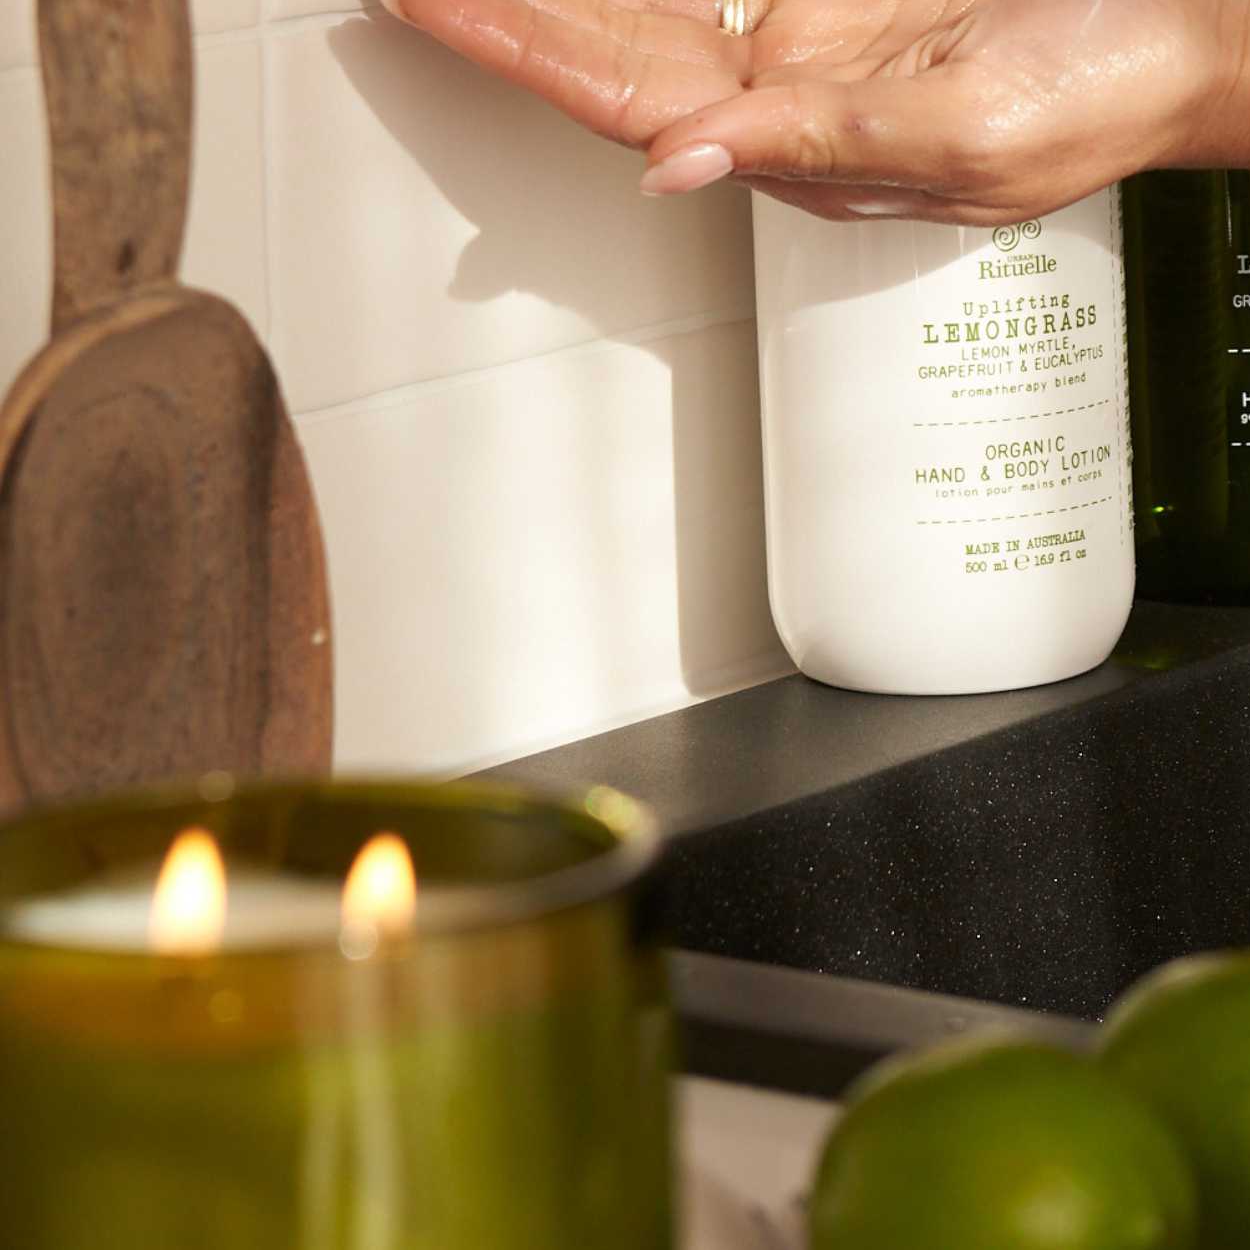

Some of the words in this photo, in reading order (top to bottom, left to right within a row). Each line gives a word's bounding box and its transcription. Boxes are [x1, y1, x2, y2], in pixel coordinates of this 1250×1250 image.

[978, 254, 1057, 279] Rituelle
[963, 294, 1070, 316] Uplifting
[923, 305, 1097, 344] LEMONGRASS
[962, 346, 1010, 361] LEMON
[1019, 337, 1076, 355] MYRTLE,
[918, 360, 1013, 379] GRAPEFRUIT
[1020, 360, 1027, 372] &
[1035, 345, 1104, 370] EUCALYPTUS
[951, 381, 1048, 398] aromatherapy
[1055, 374, 1087, 388] blend
[985, 436, 1065, 460] ORGANIC
[915, 467, 965, 484] HAND
[980, 466, 990, 481] &
[1005, 460, 1049, 479] BODY
[1062, 445, 1111, 471] LOTION
[935, 487, 979, 498] lotion
[986, 485, 1013, 497] pour
[1021, 479, 1055, 492] mains
[1061, 476, 1072, 486] et
[1078, 469, 1102, 483] corps
[965, 542, 1000, 555] MADE
[1006, 540, 1019, 552] IN
[1027, 529, 1085, 550] AUSTRALIA
[965, 561, 987, 574] 500
[993, 560, 1007, 571] ml
